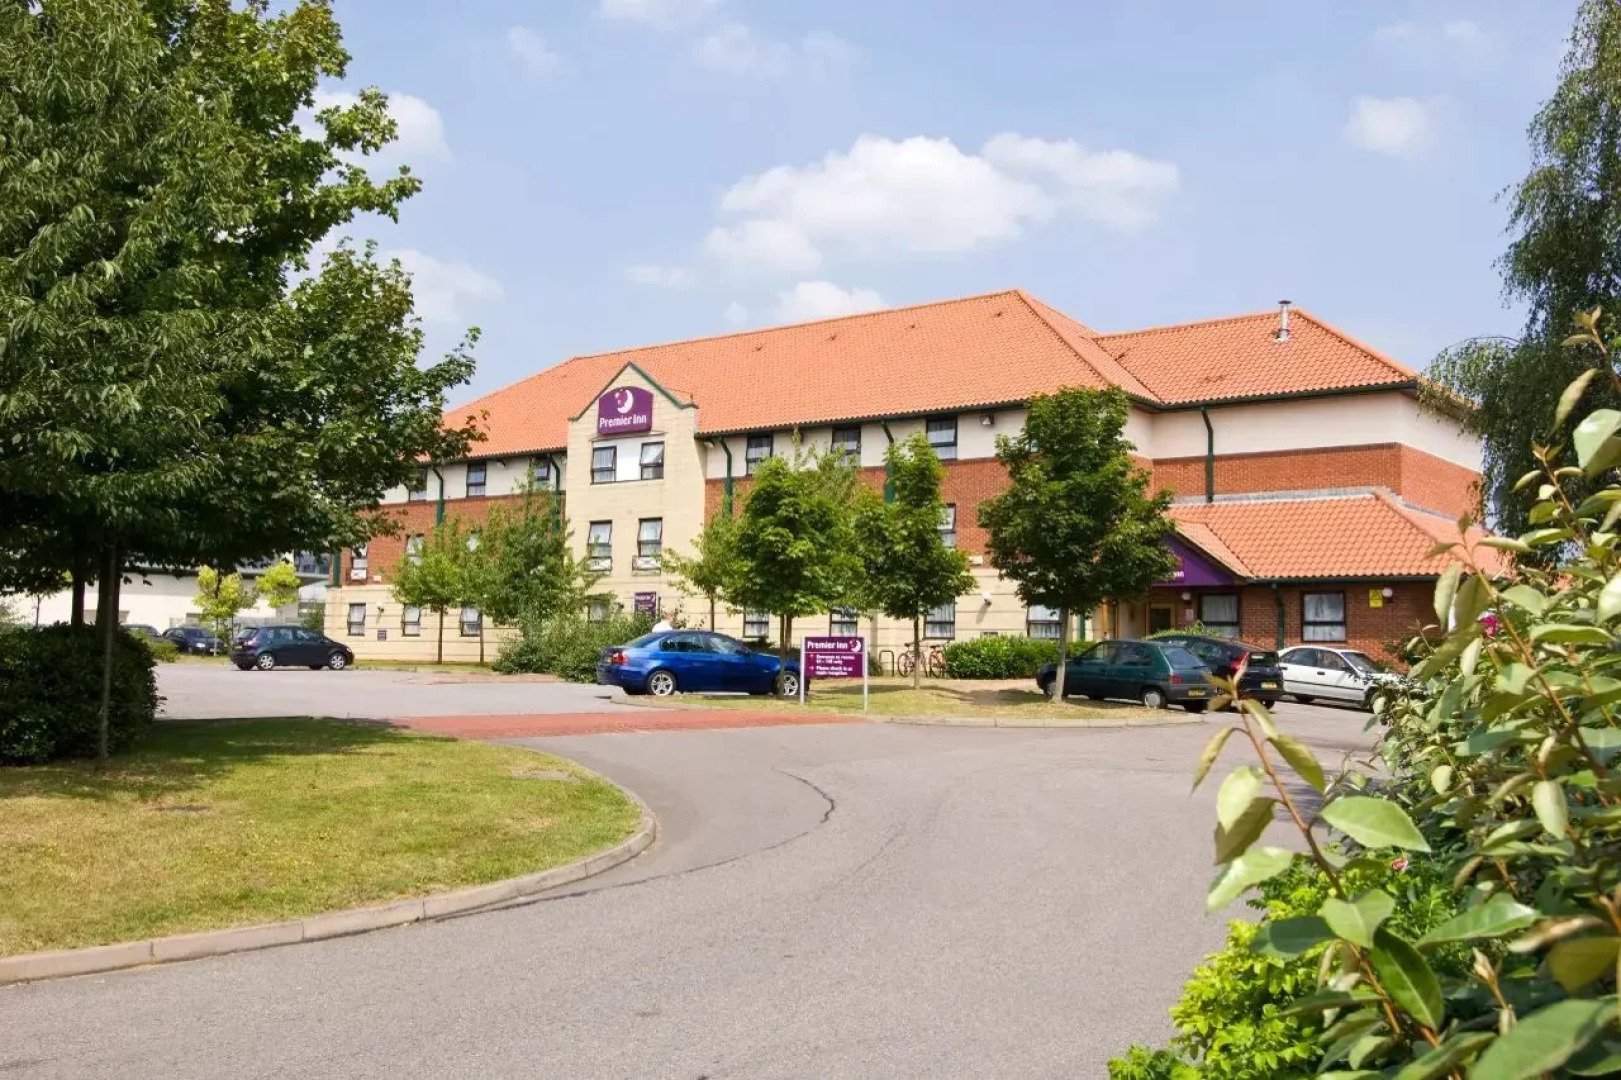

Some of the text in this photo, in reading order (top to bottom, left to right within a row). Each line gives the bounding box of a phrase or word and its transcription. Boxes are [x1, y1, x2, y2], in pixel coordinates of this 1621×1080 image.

[599, 414, 647, 428] Premier Inn
[807, 641, 848, 649] Premier Inn
